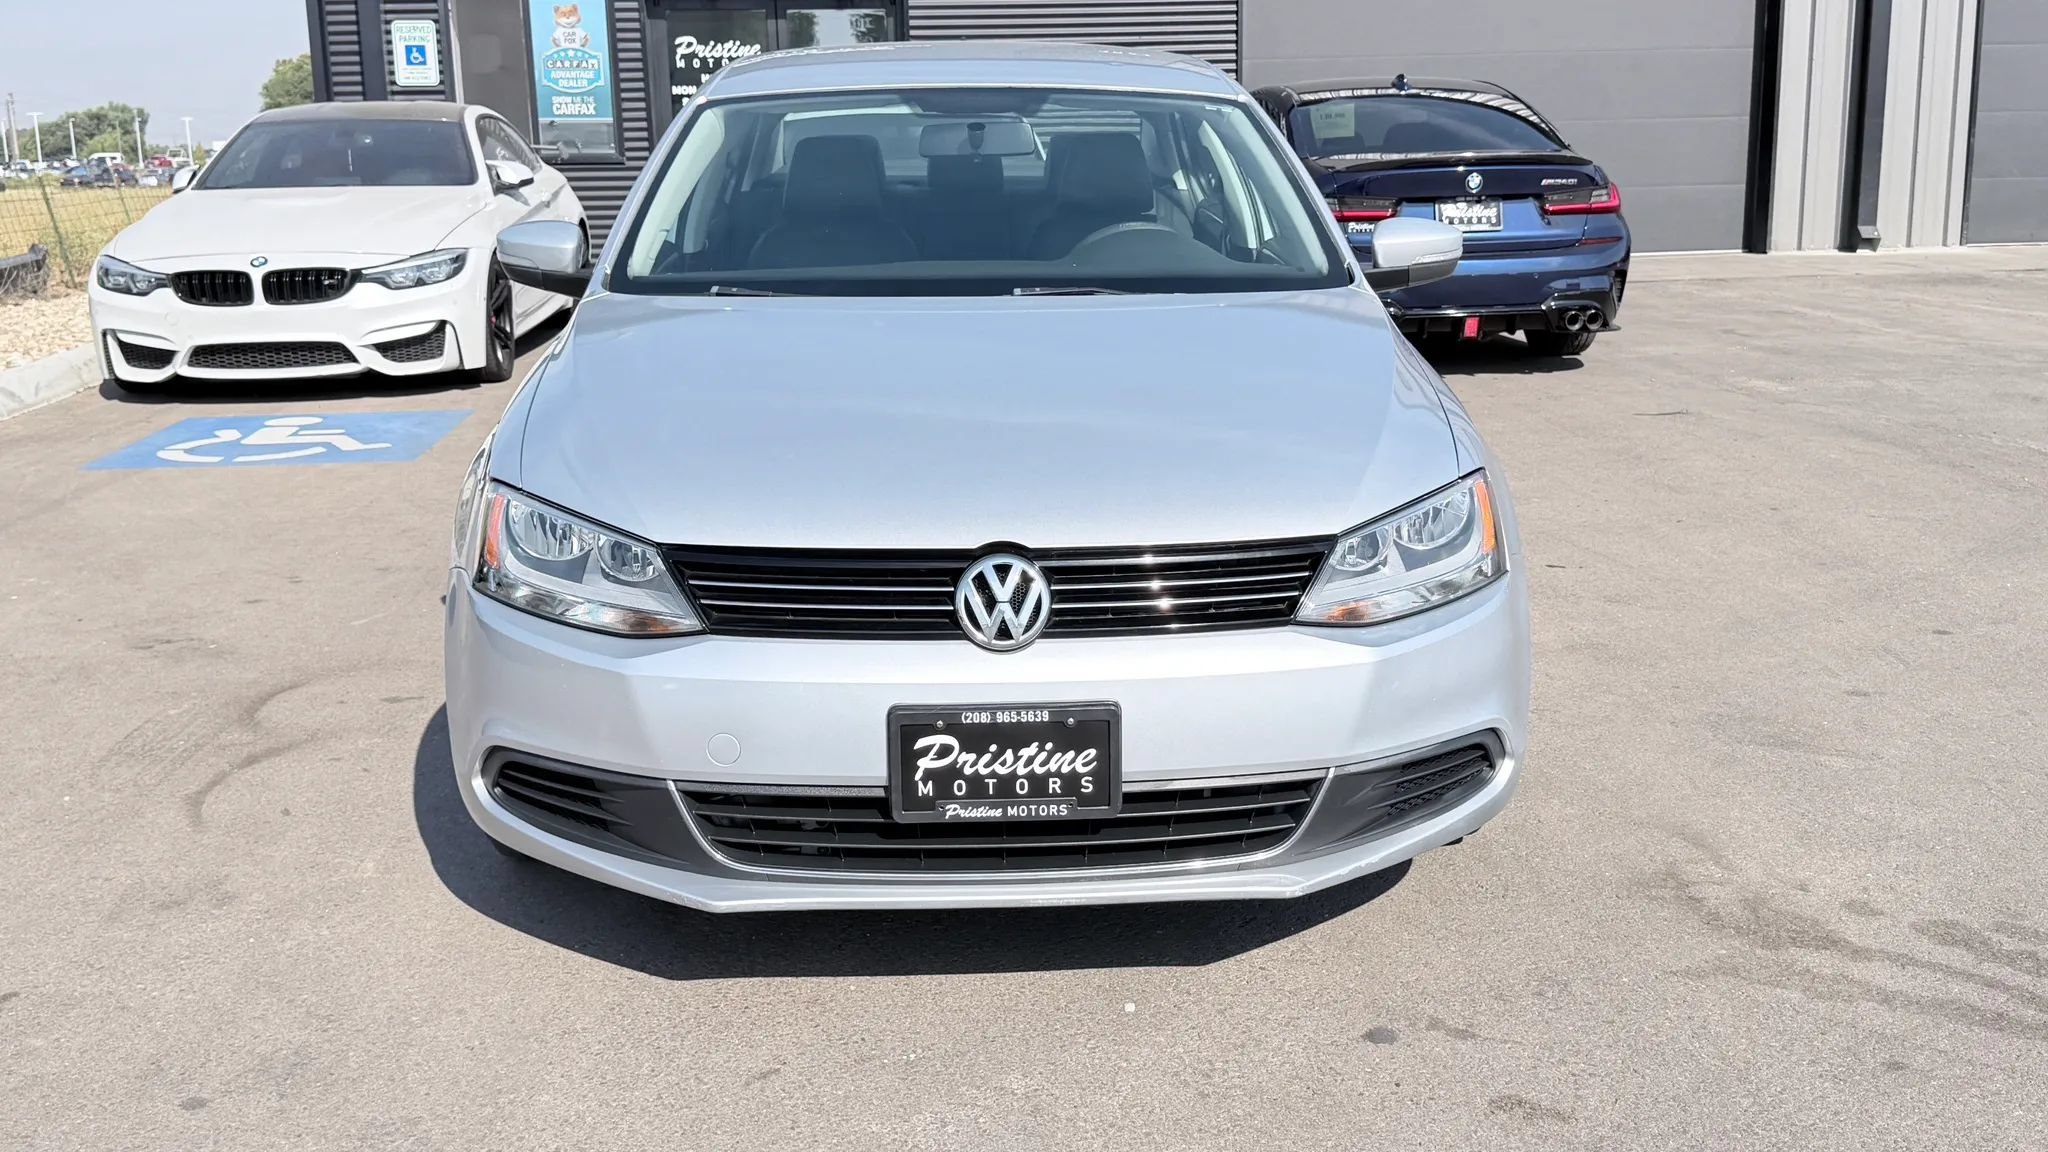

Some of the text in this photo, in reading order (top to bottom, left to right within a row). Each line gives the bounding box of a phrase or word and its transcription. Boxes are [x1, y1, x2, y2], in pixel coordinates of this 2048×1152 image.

[396, 25, 432, 34] RESERVED
[399, 35, 431, 43] PARKING
[674, 35, 762, 62] Pristine
[551, 70, 595, 79] ADVANTAGE
[558, 79, 588, 88] DEALER
[551, 95, 572, 104] SHOW
[552, 103, 597, 115] CARFAX
[961, 711, 1049, 724] (208) 965-5639
[913, 734, 1098, 781] Pristine
[917, 776, 1094, 797] MOTORS
[944, 804, 1068, 819] Pristine MOTORS
